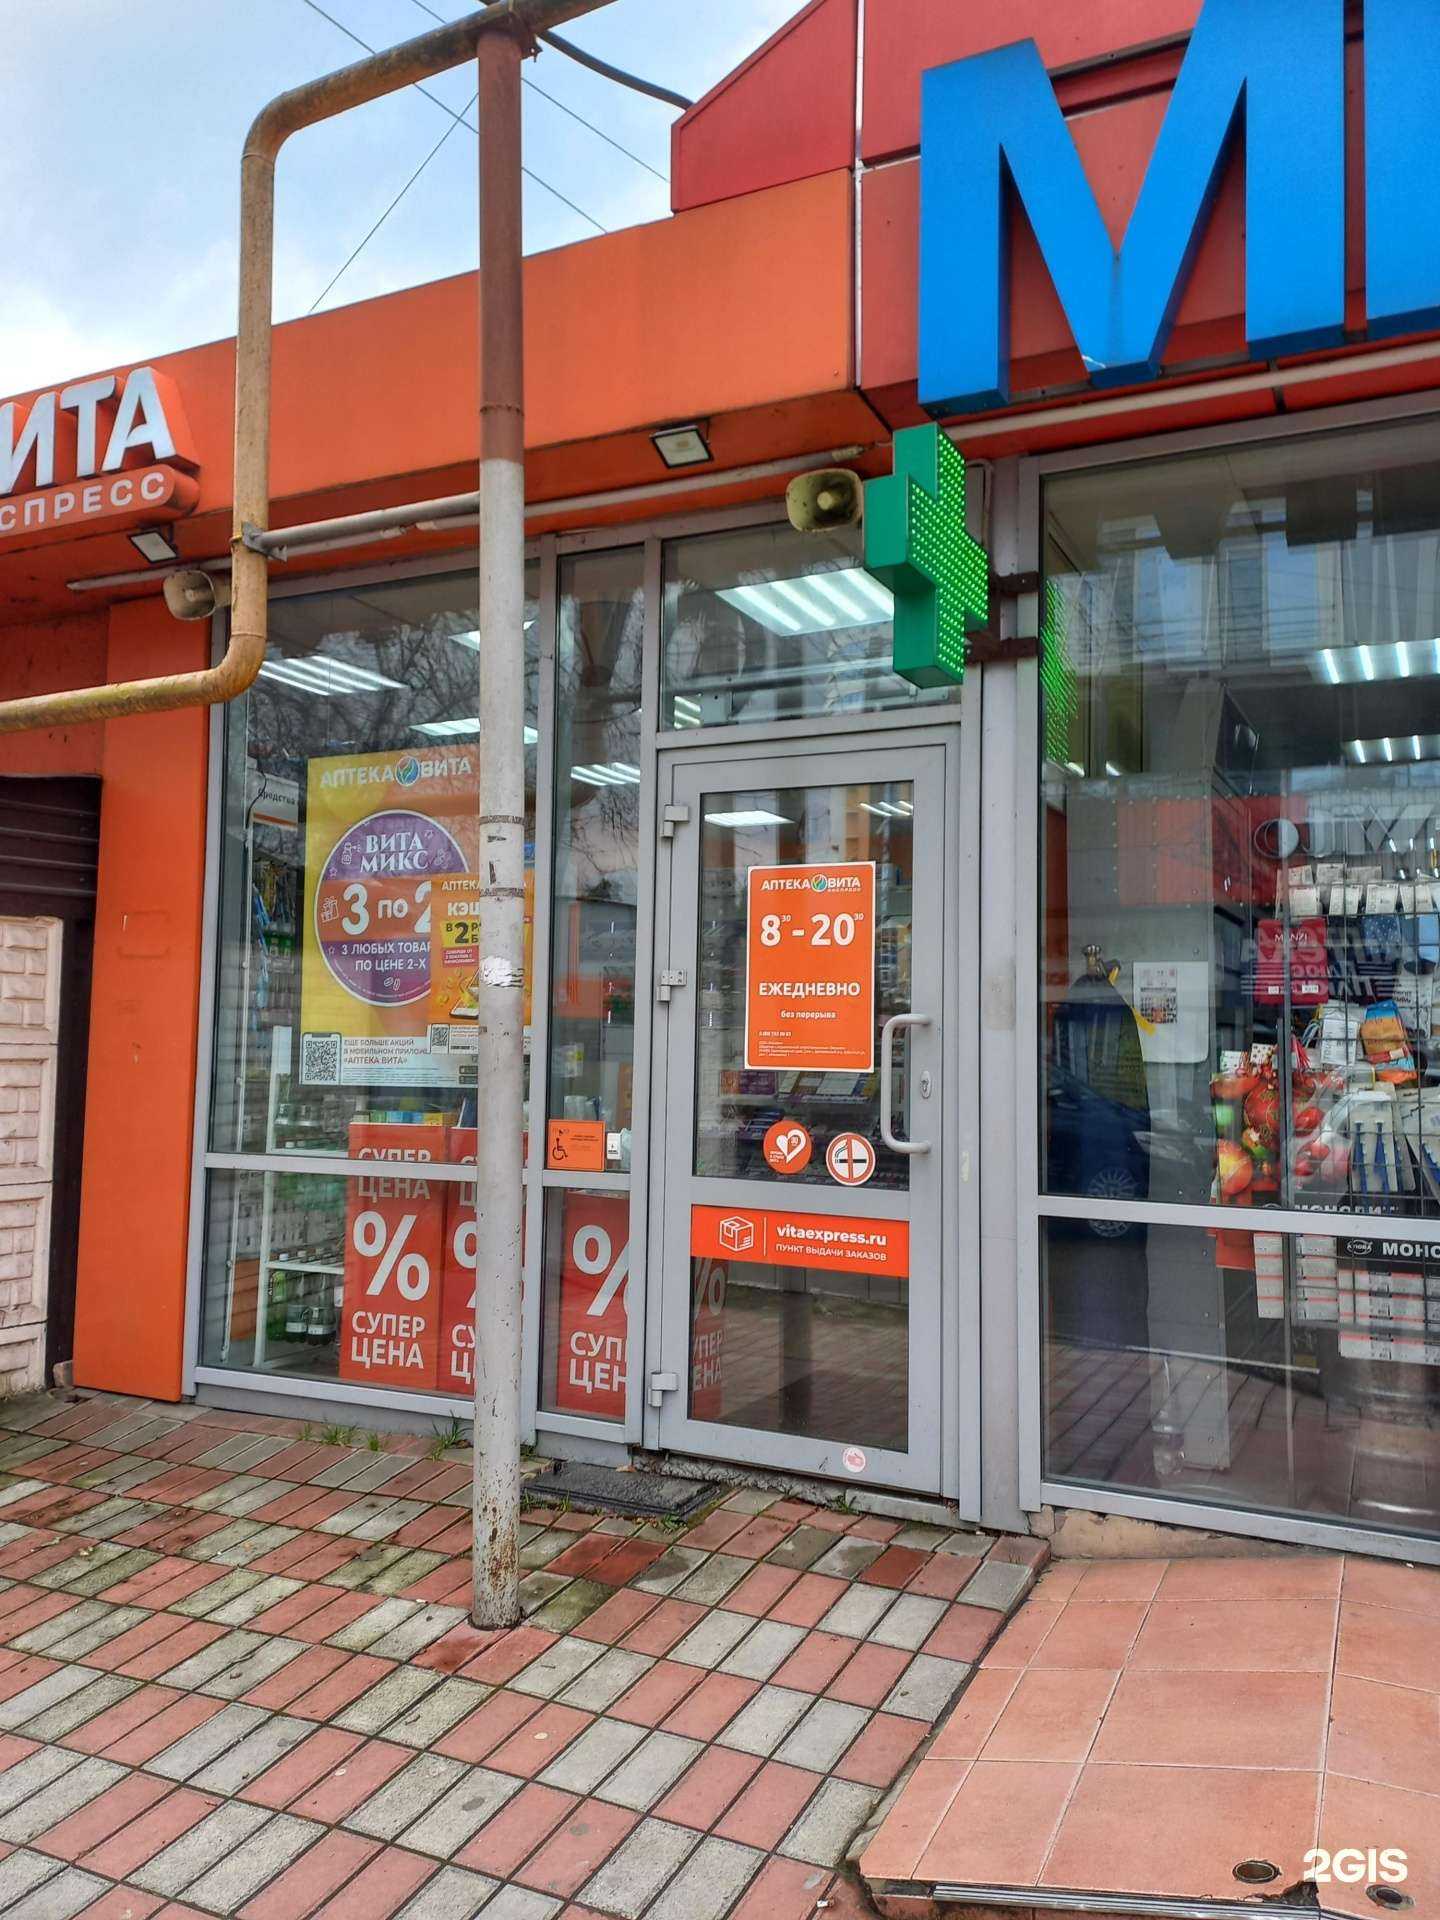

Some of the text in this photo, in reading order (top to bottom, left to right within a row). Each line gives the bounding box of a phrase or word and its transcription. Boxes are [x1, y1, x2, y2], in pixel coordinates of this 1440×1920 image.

[320, 757, 471, 788] АПТЕКА ВИТА
[366, 832, 423, 853] ВИТА
[360, 851, 428, 873] МИКС
[761, 876, 861, 891] АПТЕКА ВИТА
[342, 883, 370, 935] 3
[378, 899, 408, 919] ПО
[454, 921, 469, 944] 2
[1274, 932, 1307, 943] MNZI
[342, 945, 348, 954] 3
[351, 943, 395, 955] ЛЮБЫХ
[355, 958, 426, 972] ПО ЦЕНЕ 2-Х
[759, 982, 861, 998] ЕЖЕДНЕВНО
[781, 1010, 836, 1020] без перерыва
[358, 1176, 430, 1203] ЦЕНА
[777, 1224, 887, 1245] vitaexpress.ru
[776, 1244, 887, 1260] ПУНКТ ВЫДАЧИ ЗАКАЗОВ
[352, 1310, 426, 1339] СУПЕР
[351, 1336, 424, 1369] ЦЕНА
[570, 1331, 627, 1361] СУП
